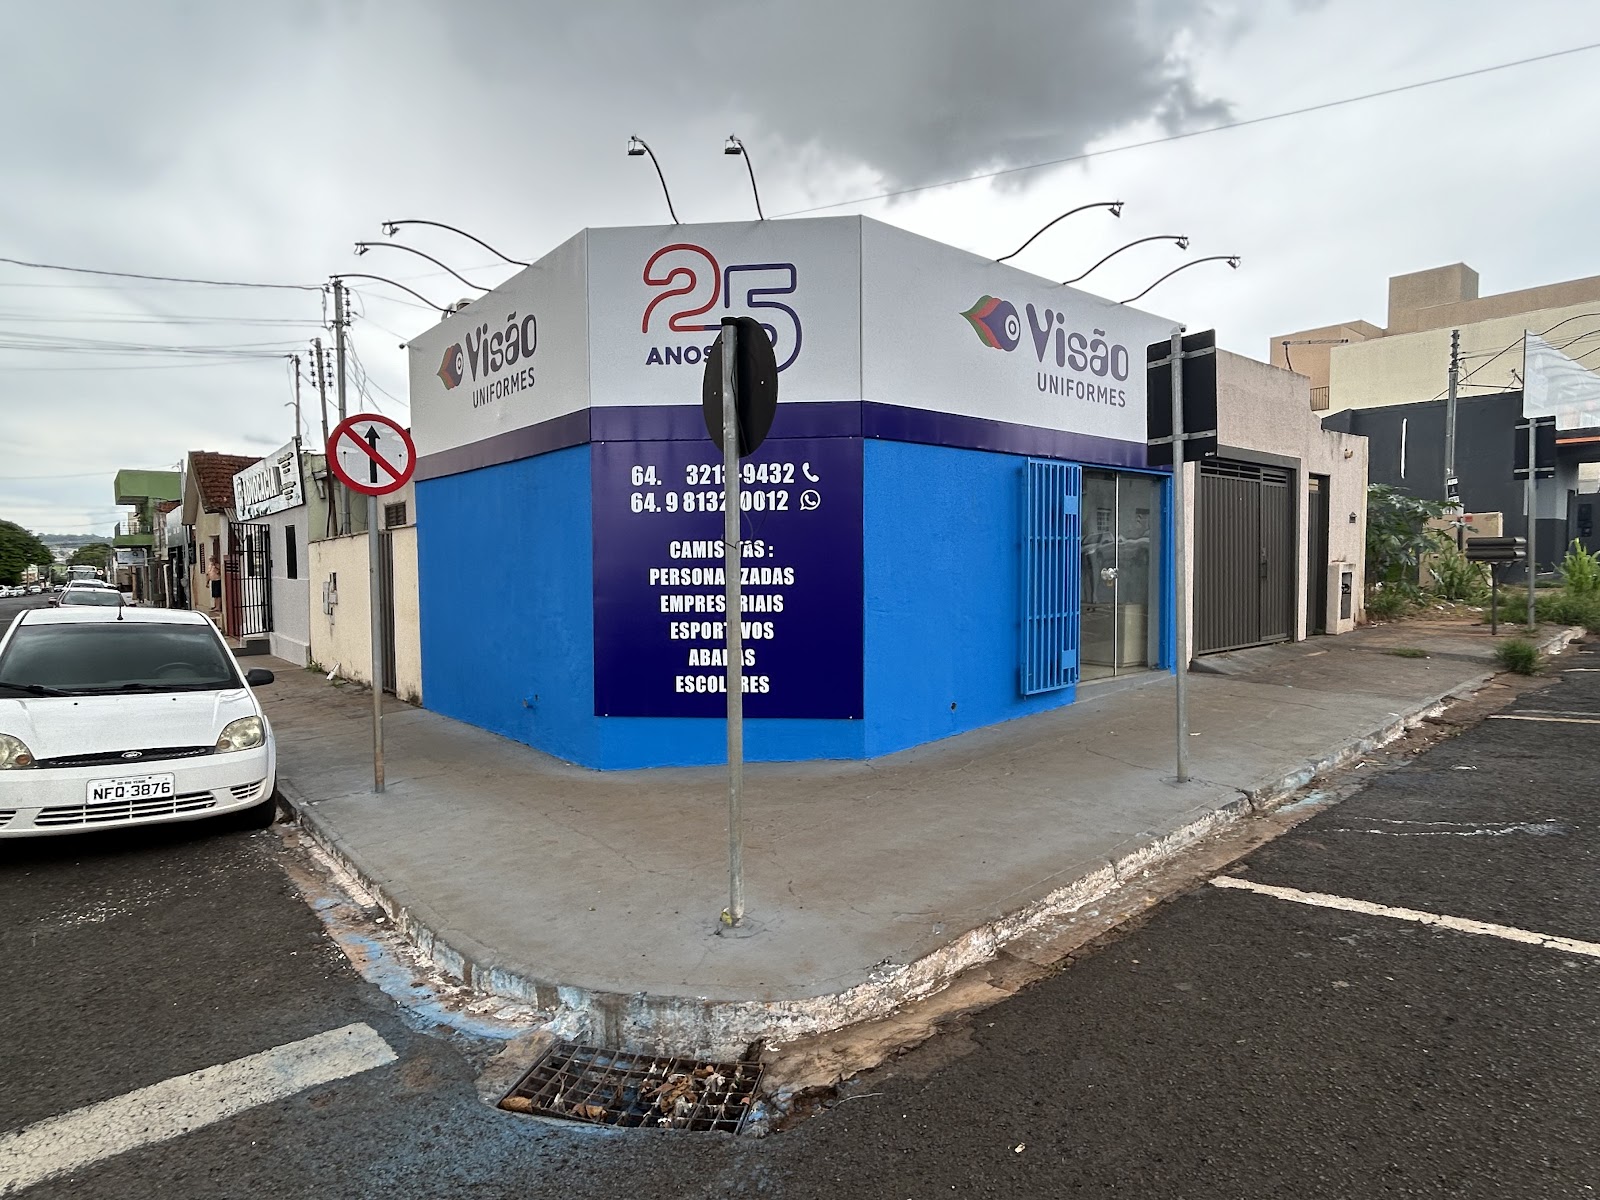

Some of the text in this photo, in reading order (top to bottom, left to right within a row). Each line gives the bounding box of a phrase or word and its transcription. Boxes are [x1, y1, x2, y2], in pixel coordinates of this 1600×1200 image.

[642, 243, 802, 373] 25
[465, 310, 537, 382] Visão
[1025, 303, 1129, 382] Visão
[472, 366, 535, 408] UNIFORMES
[1037, 371, 1126, 408] UNIFORMES
[631, 465, 662, 486] 64.
[630, 492, 661, 513] 64.
[649, 567, 795, 586] PERSONAZADAS
[660, 594, 784, 613] EMPRESRIAIS
[675, 675, 770, 694] ESCOLRES
